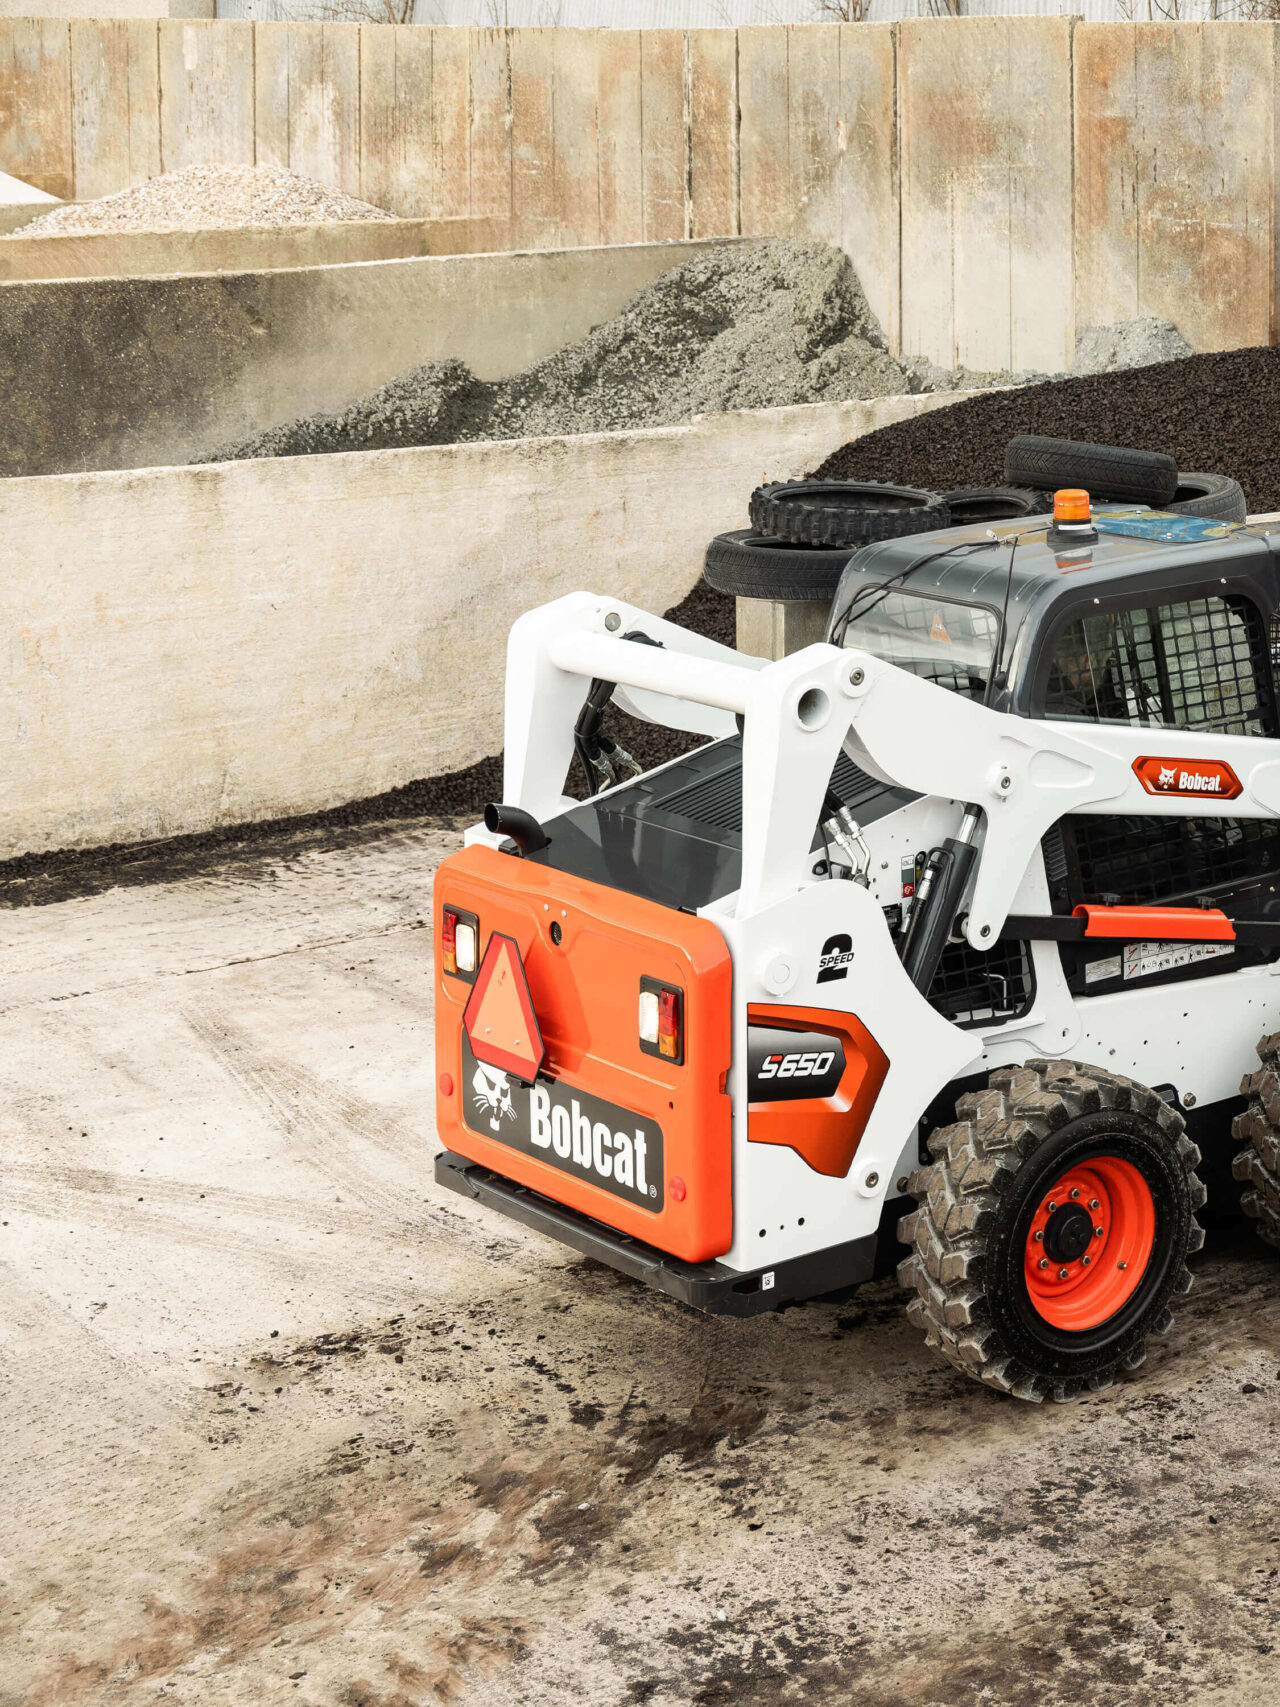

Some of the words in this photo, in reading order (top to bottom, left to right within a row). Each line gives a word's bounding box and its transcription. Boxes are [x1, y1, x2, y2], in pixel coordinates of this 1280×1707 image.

[1178, 771, 1220, 791] Bobcat
[816, 933, 853, 985] 2
[818, 952, 855, 968] SPEED
[757, 1051, 836, 1079] S650
[529, 1084, 649, 1195] Bobcat
